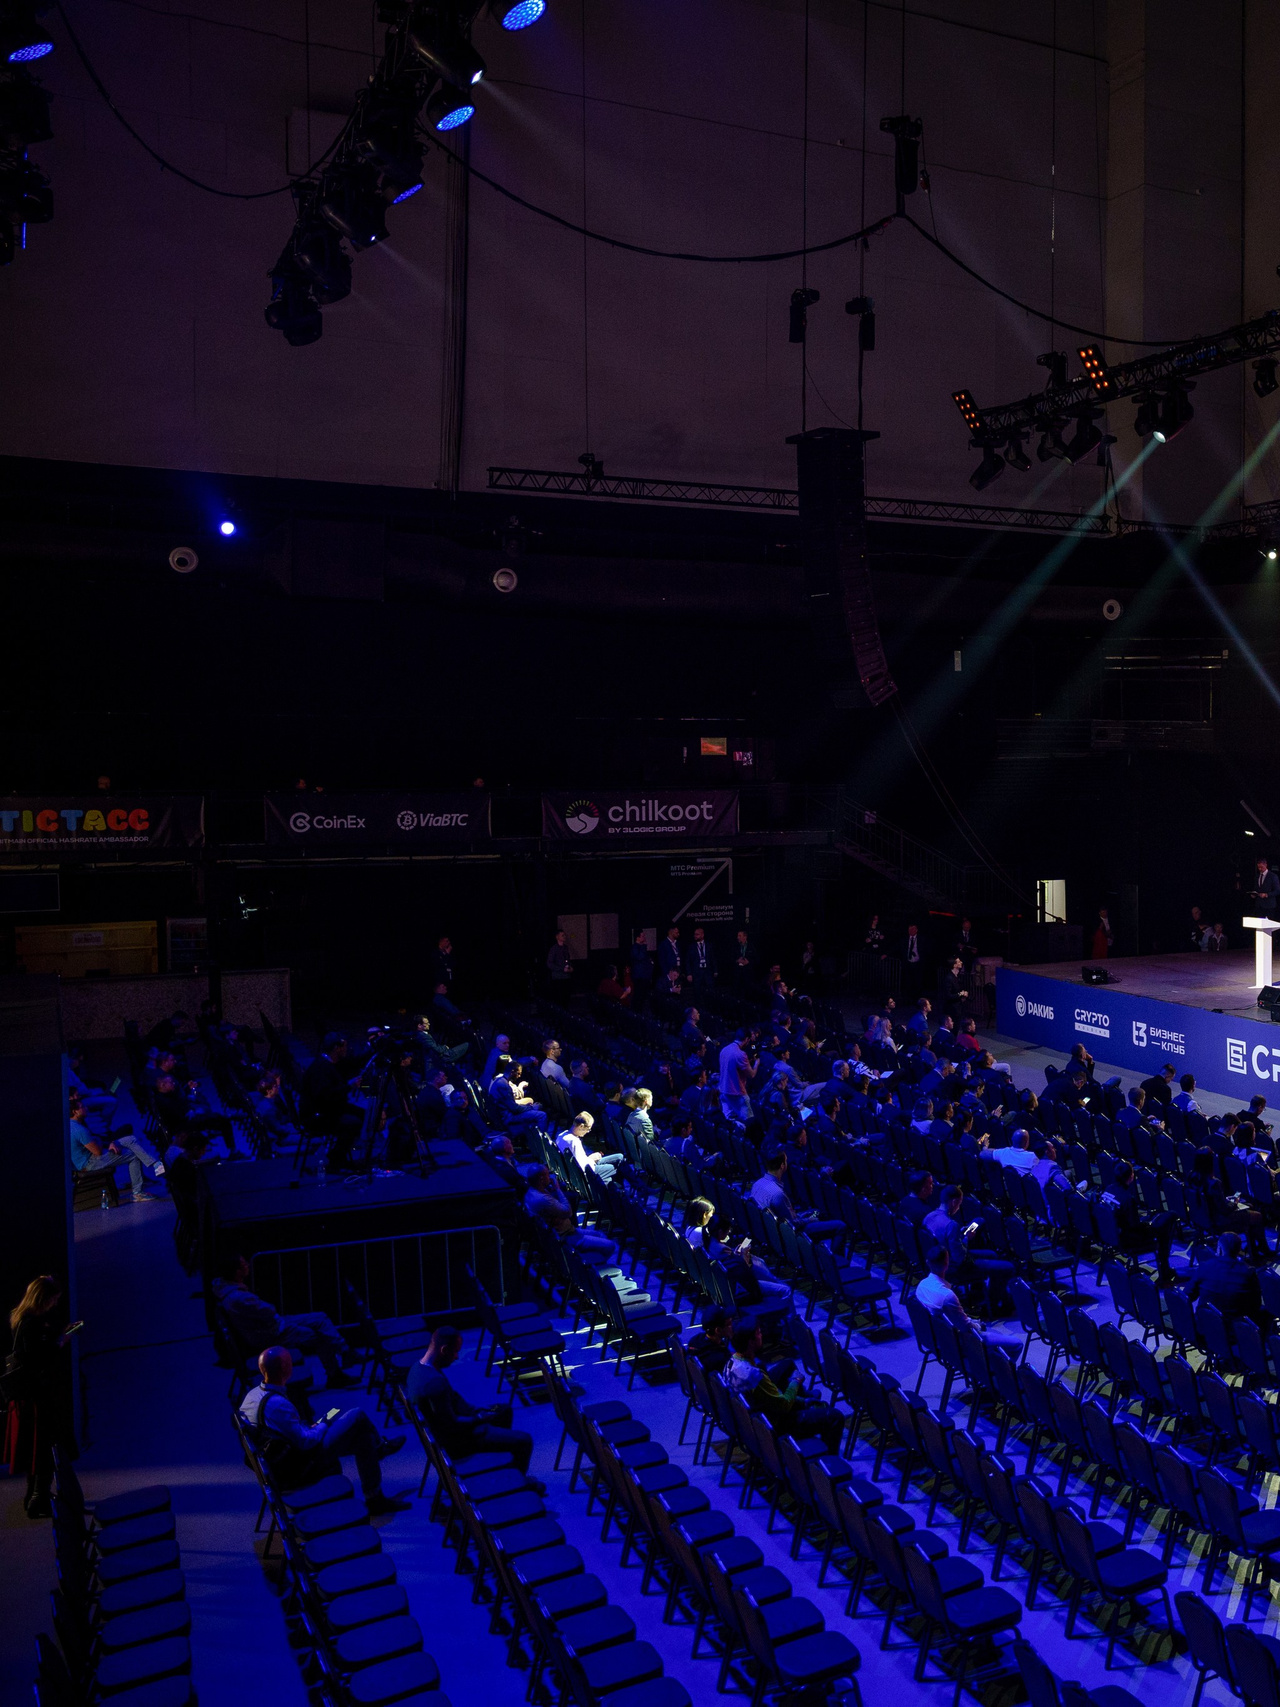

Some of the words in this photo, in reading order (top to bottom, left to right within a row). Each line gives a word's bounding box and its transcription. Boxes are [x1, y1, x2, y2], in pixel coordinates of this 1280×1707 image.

[608, 799, 713, 822] chilkoot
[0, 808, 150, 832] TICTACC
[313, 815, 366, 829] CoinEx
[419, 813, 468, 827] ViaBTC
[686, 863, 715, 871] Premium
[1027, 1001, 1054, 1020] РАКИБ
[1074, 1008, 1110, 1027] CRYPTO
[1150, 1027, 1185, 1043] БИЗНЕС
